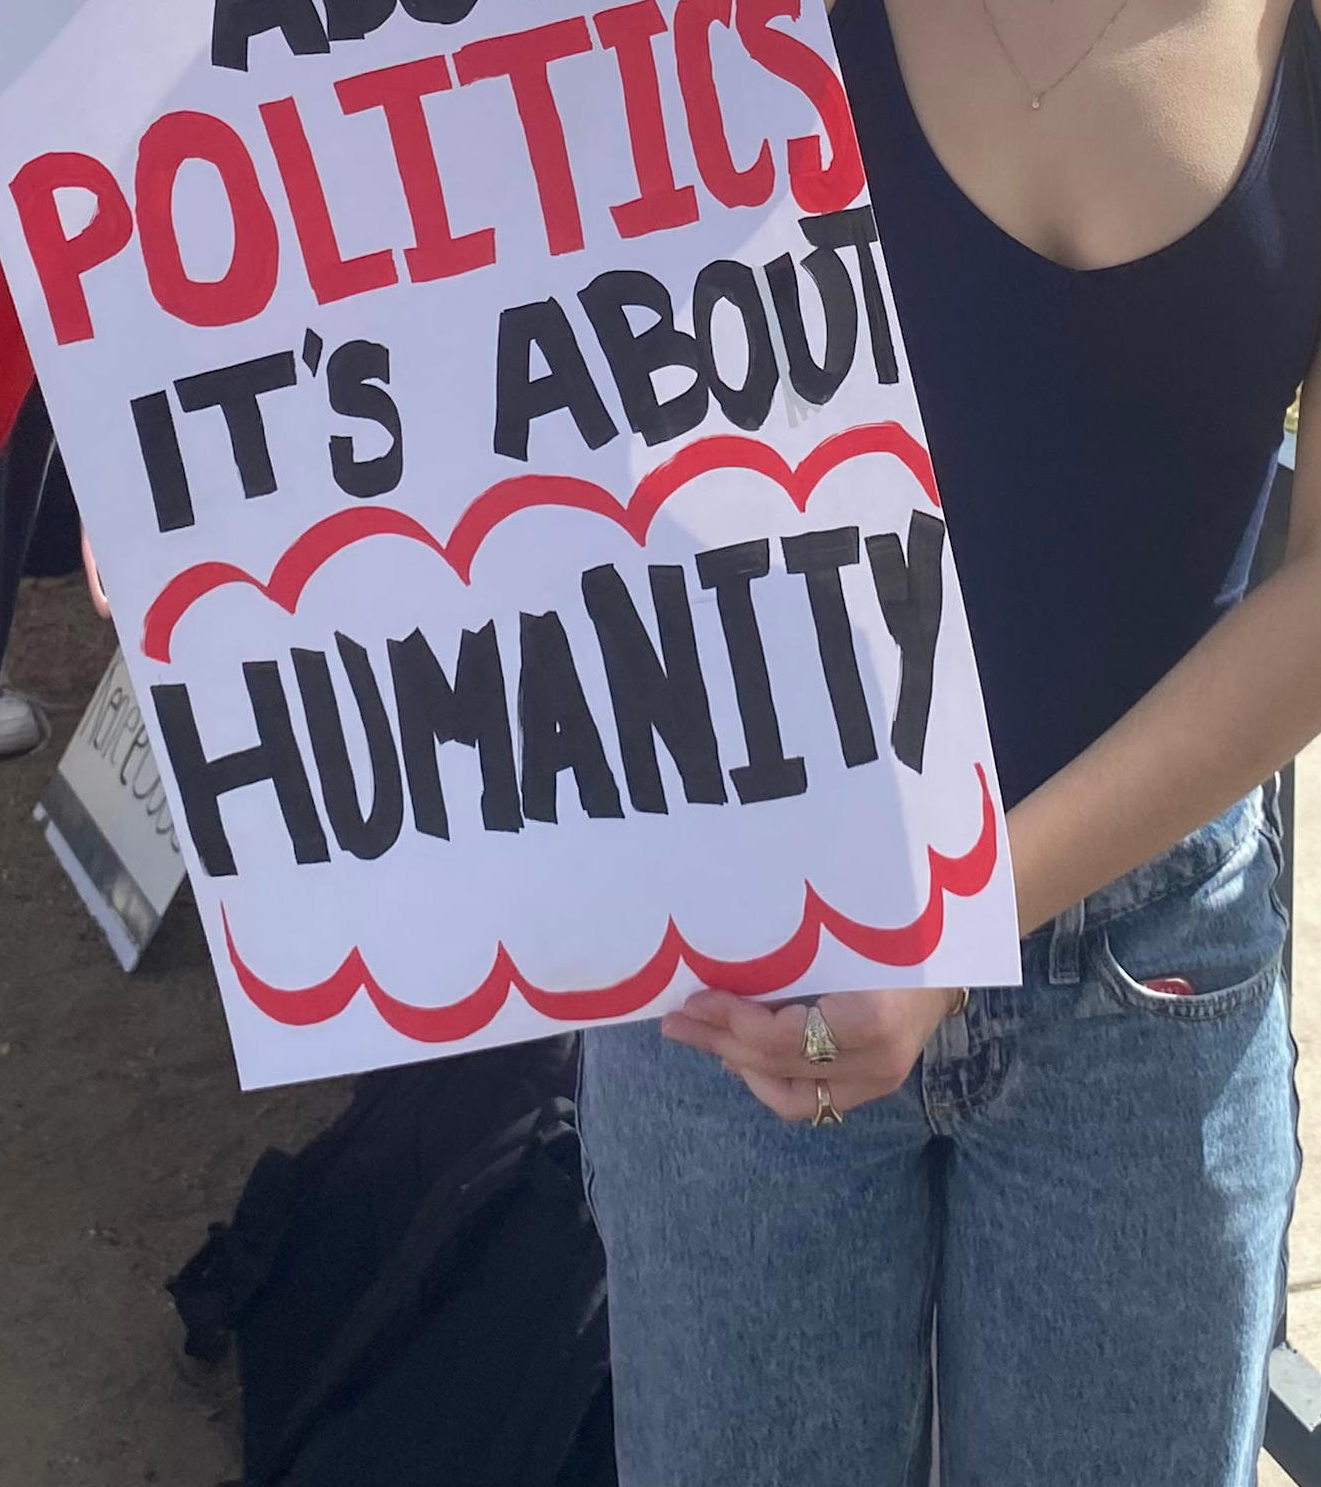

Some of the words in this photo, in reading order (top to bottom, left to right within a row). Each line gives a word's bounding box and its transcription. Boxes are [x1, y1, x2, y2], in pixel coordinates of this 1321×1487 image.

[130, 327, 403, 533] IT'S
[493, 204, 899, 460] ABOUT
[151, 510, 945, 877] HUMANITY
